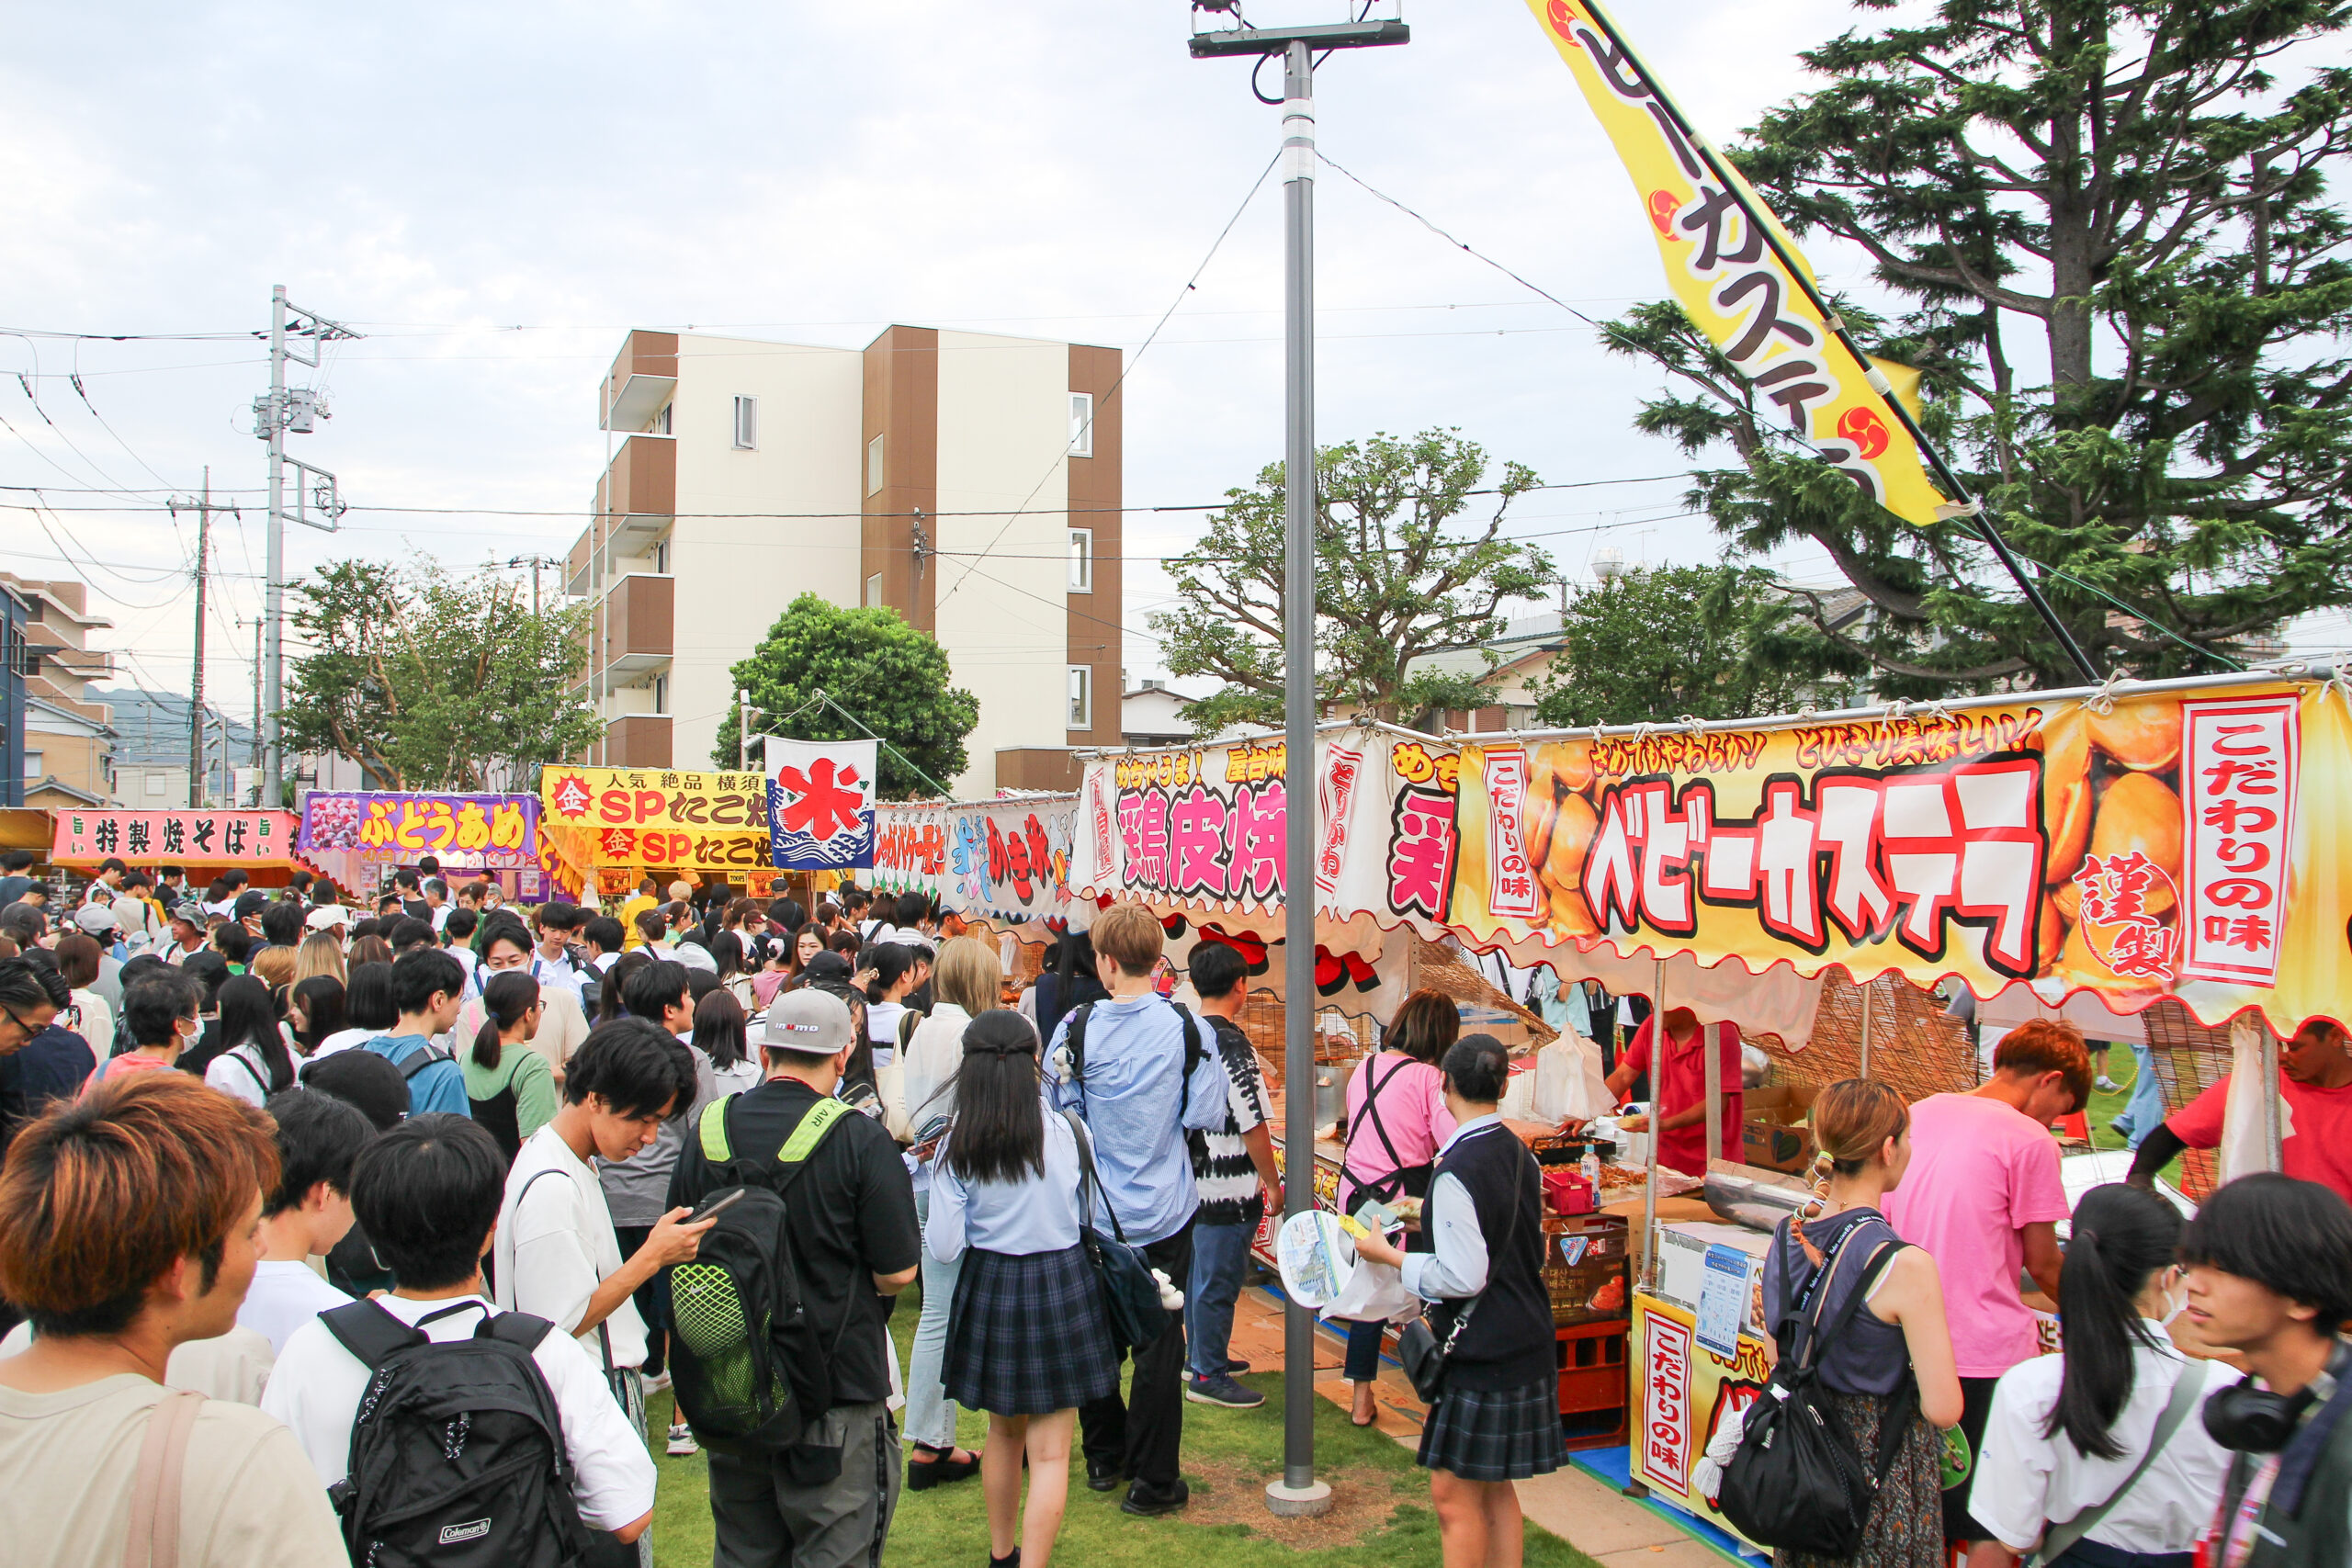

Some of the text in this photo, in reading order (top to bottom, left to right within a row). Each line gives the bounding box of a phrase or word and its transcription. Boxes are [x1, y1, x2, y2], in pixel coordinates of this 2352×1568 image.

[1226, 742, 1286, 784] 屋台味
[1794, 708, 2042, 770] とびきり美味しい！
[557, 780, 589, 813] 金
[606, 773, 766, 791] 人気 絶品 横須
[778, 757, 864, 841] 氷
[71, 816, 85, 855] 旨い
[95, 818, 249, 855] 特製焼そば
[255, 818, 271, 857] 旨い
[359, 801, 526, 850] ぶどうあめ
[1117, 784, 1286, 898] 鶏皮焼
[1320, 759, 1355, 879] とりかわ
[1488, 762, 1533, 900] こだわりの味
[2201, 724, 2278, 953] こだわりの味
[1582, 751, 2047, 977] ベビーカステラ
[2072, 852, 2174, 981] 謹製
[810, 1108, 829, 1127] AIR
[1651, 1330, 1682, 1472] こだわりの味
[445, 1525, 481, 1539] Coleman
